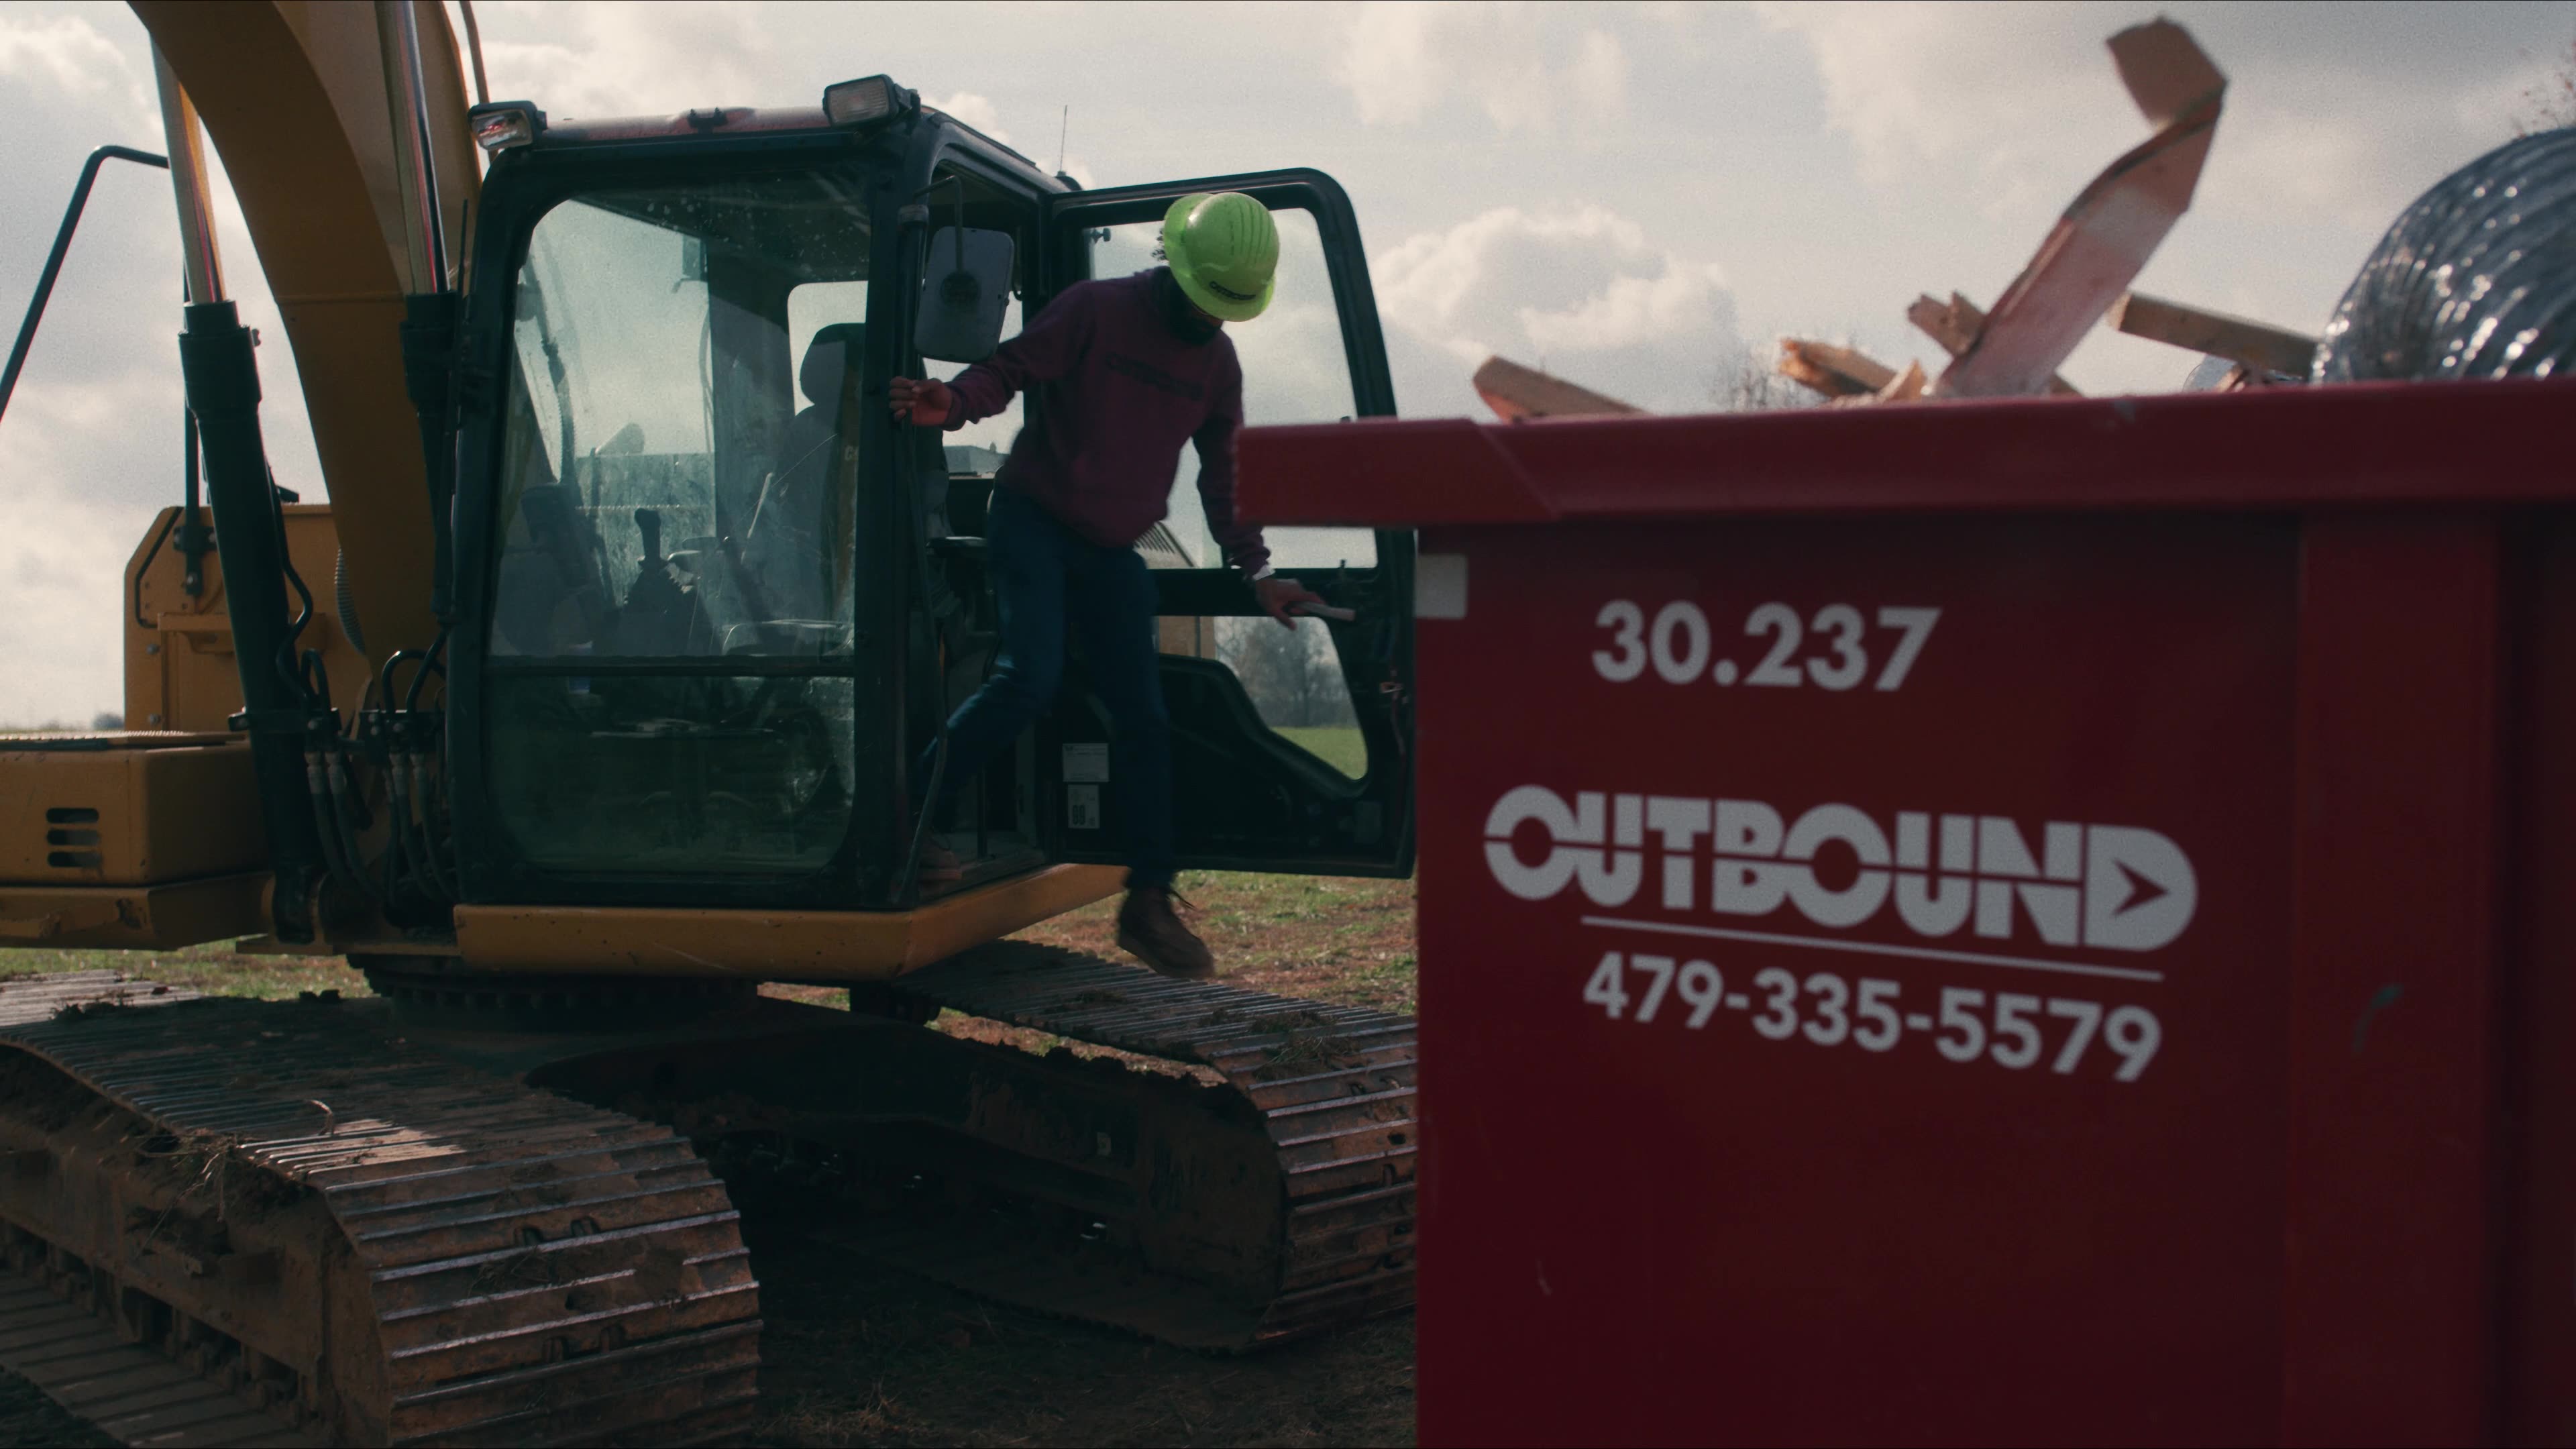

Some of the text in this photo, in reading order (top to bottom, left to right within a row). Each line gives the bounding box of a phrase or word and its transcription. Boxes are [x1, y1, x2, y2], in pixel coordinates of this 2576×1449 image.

[1592, 600, 1941, 691] 30.237
[1483, 784, 2198, 952] OUTBOUND
[1583, 951, 2161, 1081] 479-335-5579
